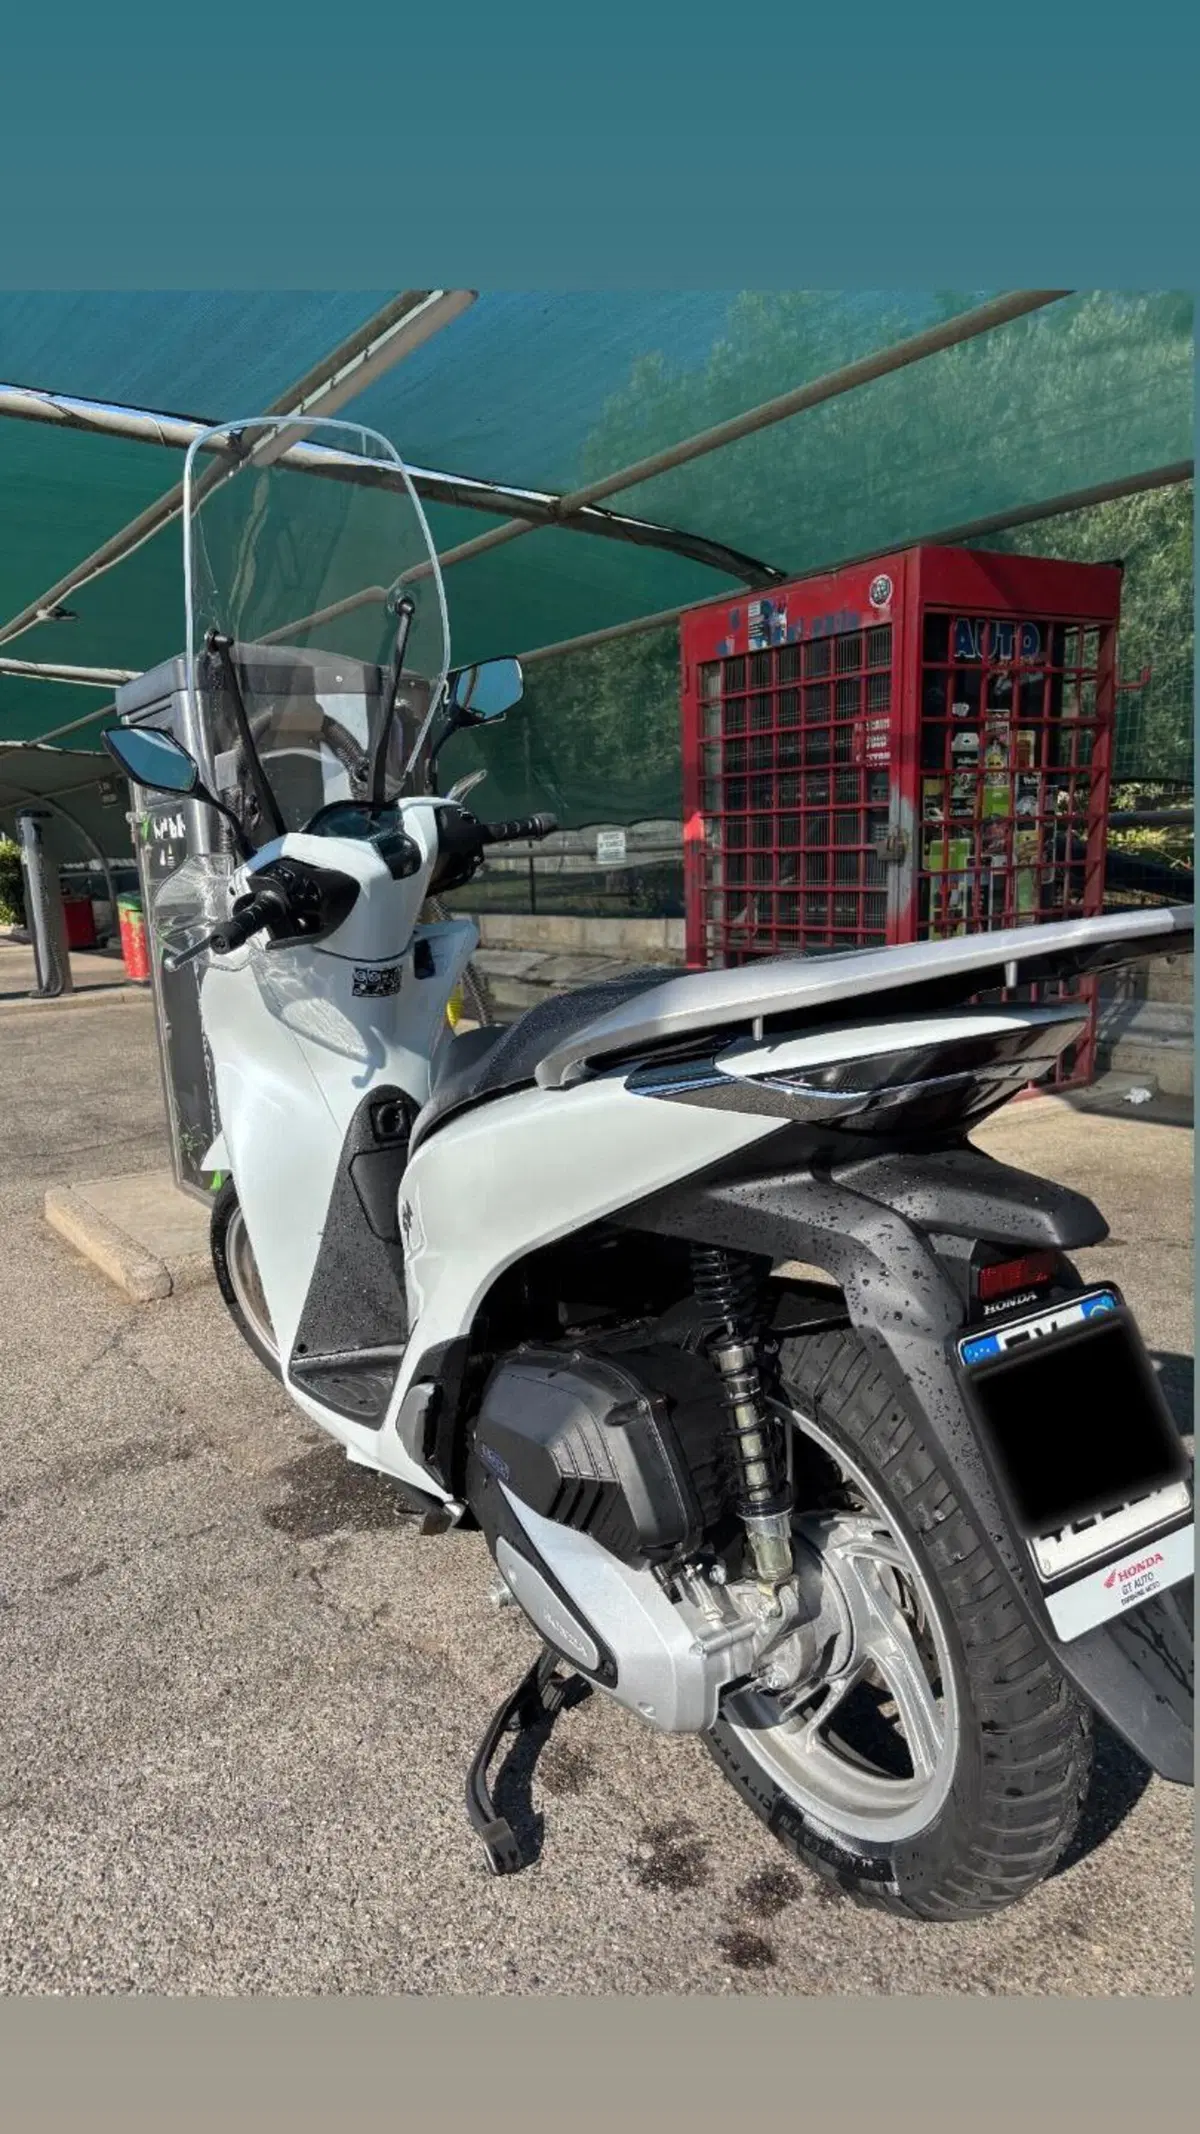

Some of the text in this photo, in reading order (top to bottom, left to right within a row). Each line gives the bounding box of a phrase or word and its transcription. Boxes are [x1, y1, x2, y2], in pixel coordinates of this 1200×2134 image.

[953, 617, 1041, 659] AUTO
[983, 1291, 1038, 1316] HONDA
[1117, 1553, 1164, 1582] HONDA
[1121, 1571, 1155, 1596] GT AUTO
